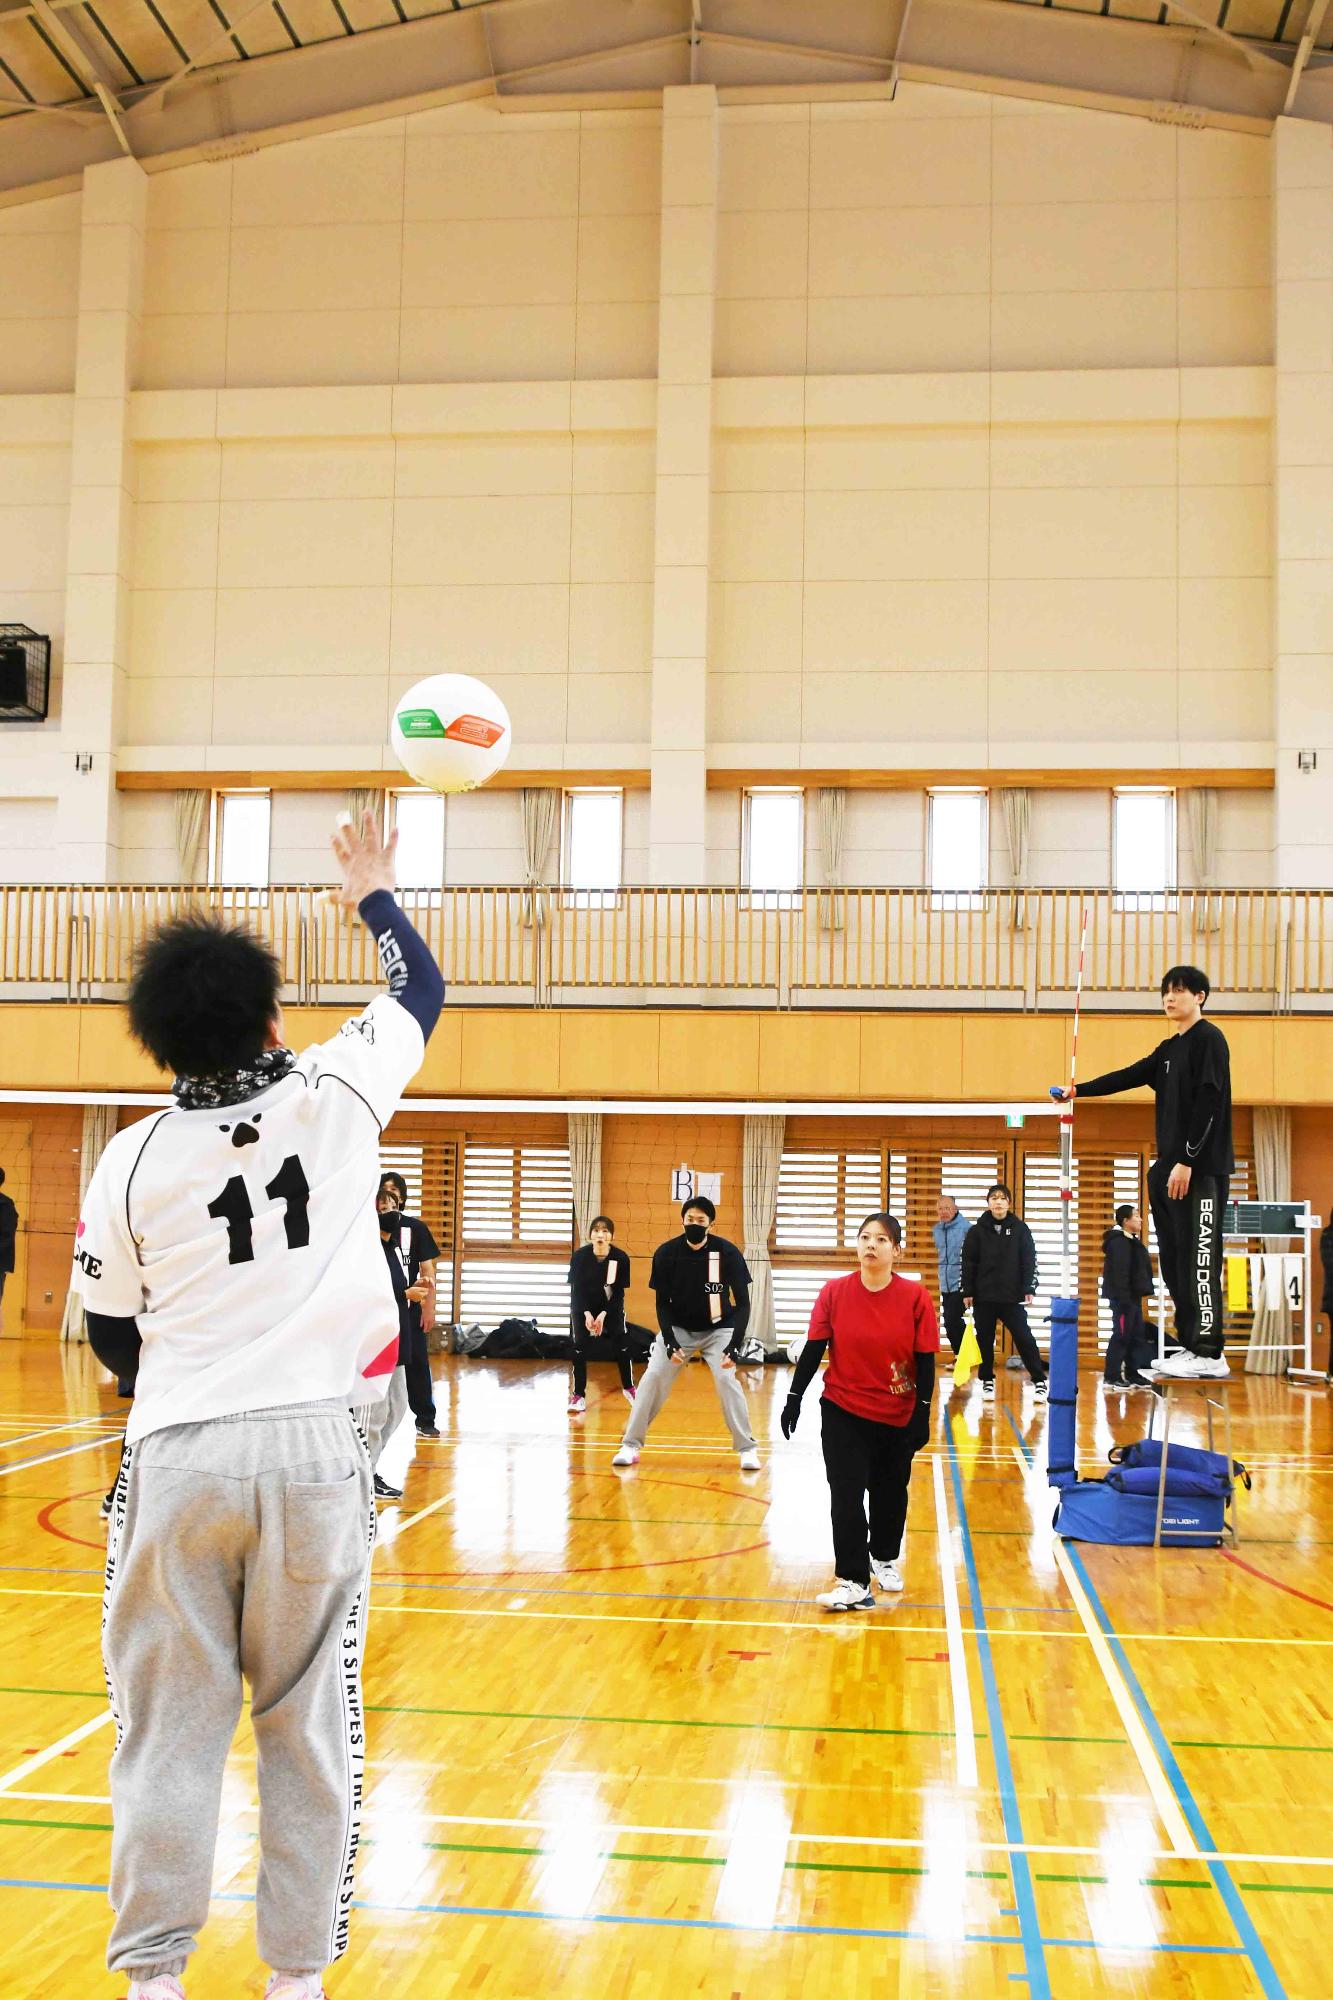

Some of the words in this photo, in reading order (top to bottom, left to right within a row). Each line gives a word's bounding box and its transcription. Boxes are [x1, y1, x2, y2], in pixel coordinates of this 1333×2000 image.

[377, 928, 409, 1000] NDER
[207, 1153, 310, 1265] 11
[673, 1170, 693, 1201] B
[1197, 1199, 1214, 1267] BEAMS
[1197, 1269, 1214, 1336] DESIGN
[1288, 1275, 1302, 1306] 4
[116, 1446, 133, 1530] STRIPES
[343, 1638, 357, 1648] 3
